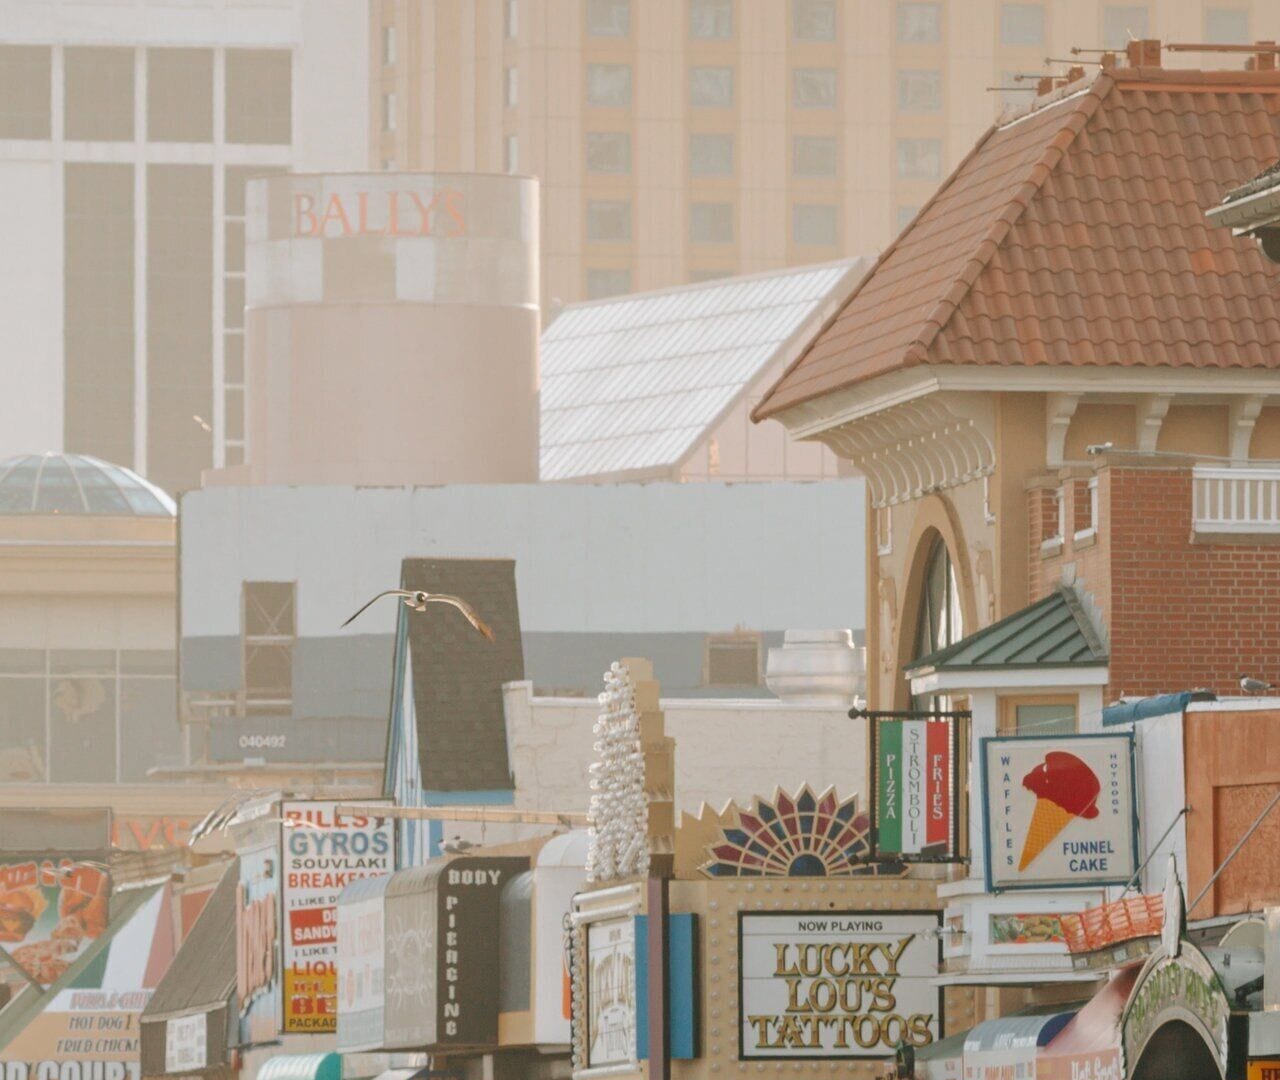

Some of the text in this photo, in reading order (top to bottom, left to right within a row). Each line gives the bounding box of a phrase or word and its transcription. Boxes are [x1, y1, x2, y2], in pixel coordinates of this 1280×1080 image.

[886, 754, 896, 819] PIZZA
[908, 729, 920, 845] STROMBOLI
[932, 755, 943, 820] FRIES
[1001, 756, 1013, 866] WAFFLES
[289, 832, 389, 856] GYROS
[1063, 841, 1114, 855] FUNNEL
[292, 858, 387, 869] SOUVLAKI
[1069, 858, 1108, 872] CAKE
[288, 872, 388, 889] BREAKF
[448, 869, 501, 886] BODY
[298, 896, 324, 906] LIKE
[798, 921, 883, 932] NOW PLAYING
[302, 946, 328, 956] LIKE
[773, 934, 916, 977] LUCKY
[444, 895, 460, 1037] PIERCING
[785, 977, 897, 1013] LOU'S
[70, 1016, 122, 1030] HOT DOG
[748, 1014, 933, 1049] TATTOOS
